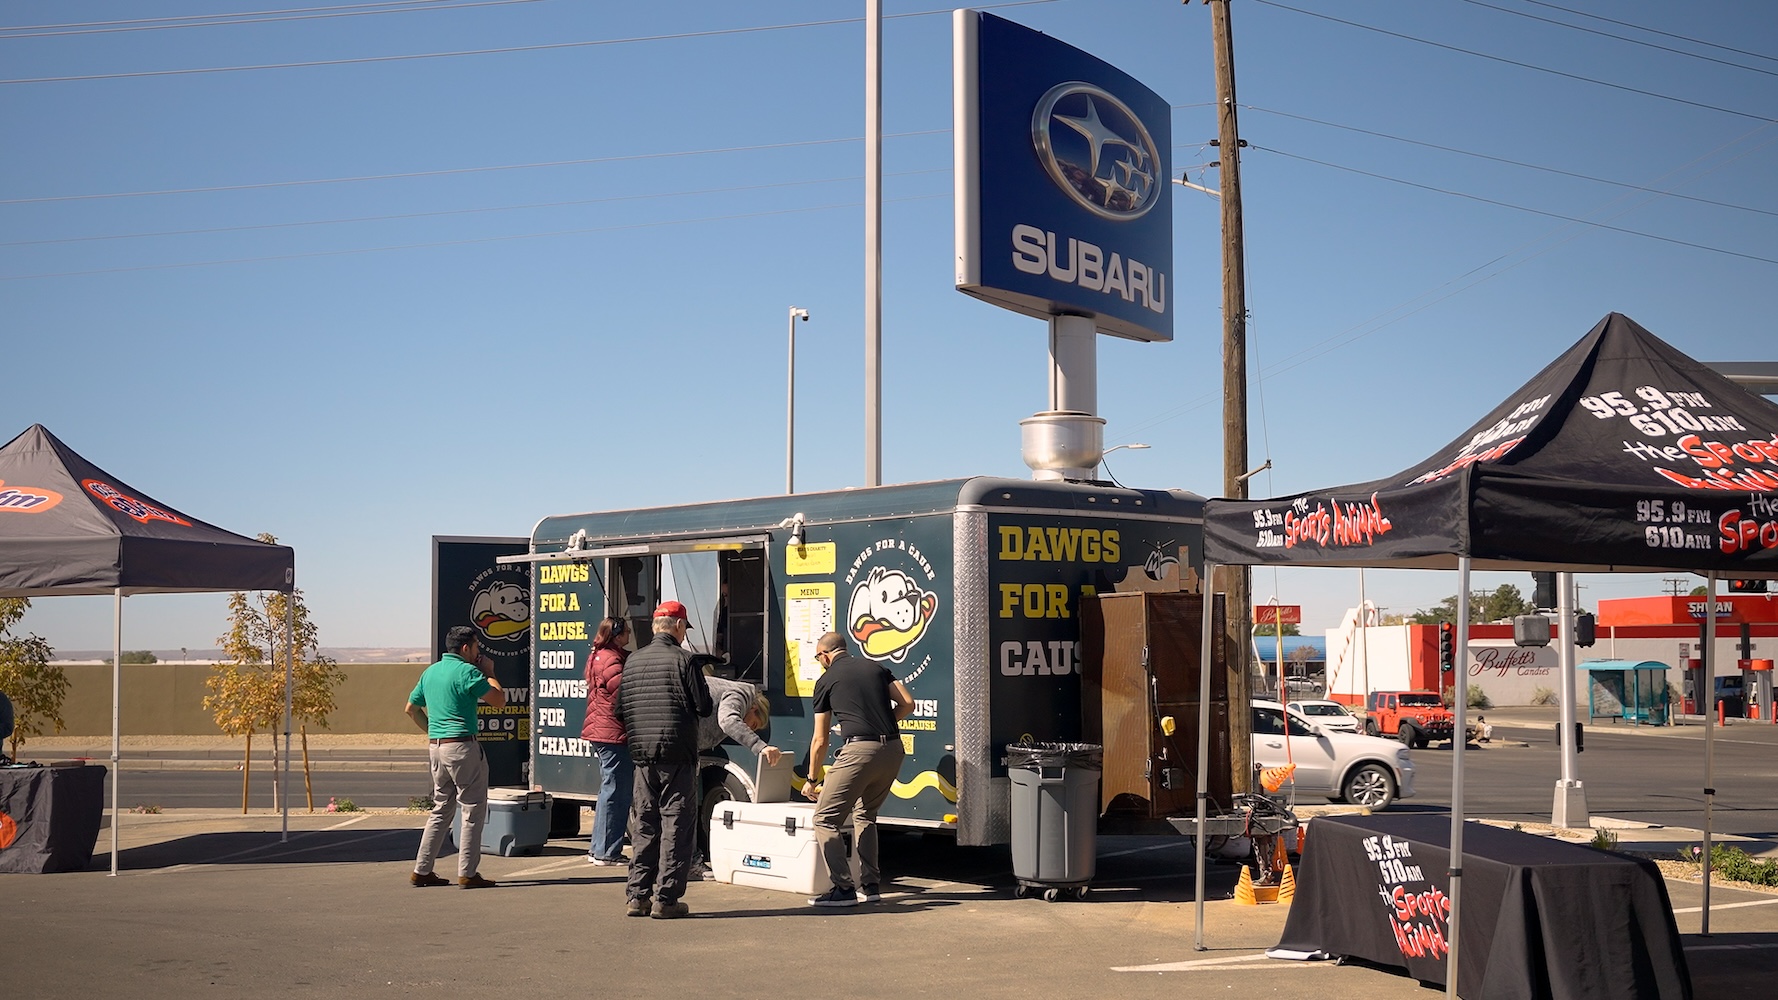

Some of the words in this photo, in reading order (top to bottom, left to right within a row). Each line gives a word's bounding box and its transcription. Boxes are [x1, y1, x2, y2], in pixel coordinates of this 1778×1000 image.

[1012, 224, 1165, 314] SUBARU
[1623, 441, 1687, 461] the
[998, 526, 1120, 563] DAWGS
[845, 547, 873, 585] DAWGS
[875, 539, 895, 551] FOR
[898, 540, 905, 550] A
[908, 545, 935, 580] CAUSE
[469, 567, 493, 591] DAWGS
[540, 564, 589, 584] DAWGS
[540, 593, 566, 612] FOR
[568, 592, 580, 611] A
[800, 588, 820, 596] MENU
[999, 583, 1070, 618] FOR
[1687, 602, 1733, 613] SHAN
[540, 621, 588, 641] CAUSE.
[540, 651, 574, 669] GOOD
[1000, 641, 1081, 676] CAU
[1469, 648, 1535, 677] Buffett's
[905, 654, 932, 684] CHARITY
[1517, 666, 1550, 676] Candies
[539, 679, 588, 698] DAWGS
[539, 708, 565, 727] FOR
[539, 736, 599, 758] CHARIT
